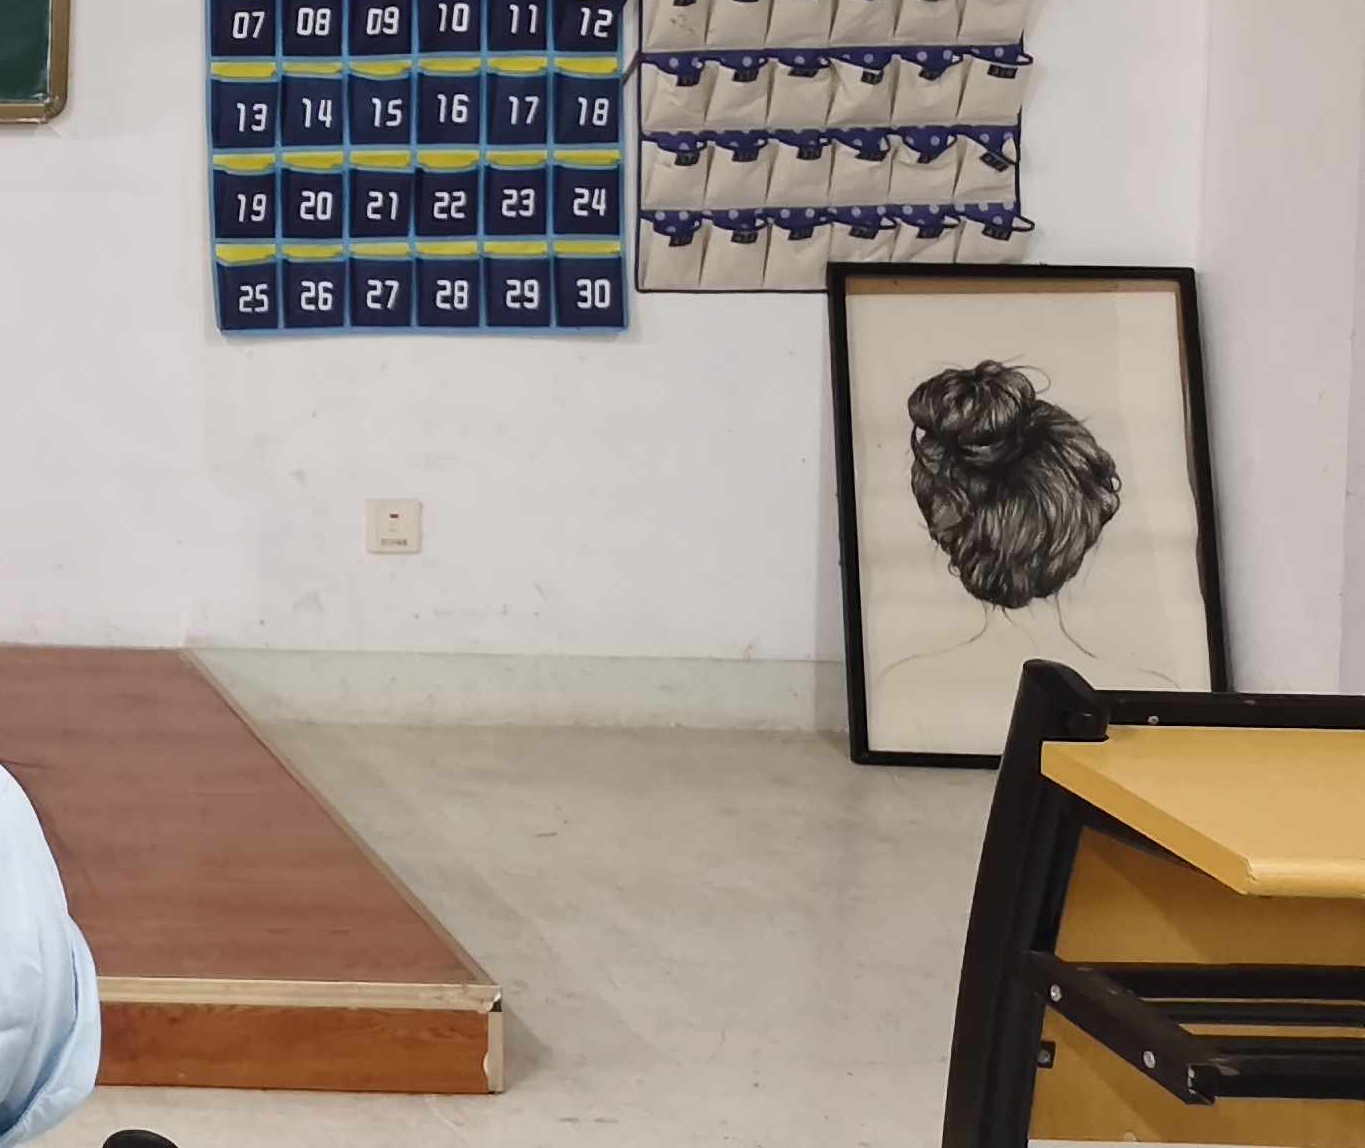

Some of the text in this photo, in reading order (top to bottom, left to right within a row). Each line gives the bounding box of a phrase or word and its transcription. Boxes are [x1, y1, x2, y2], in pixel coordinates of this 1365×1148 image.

[232, 2, 614, 39] 07 08 09 10 11 12
[236, 93, 610, 133] 13 14 15 16 17 18
[236, 187, 607, 223] 19 20 21 22 23 24
[238, 278, 611, 313] 25 26 27 28 29 30
